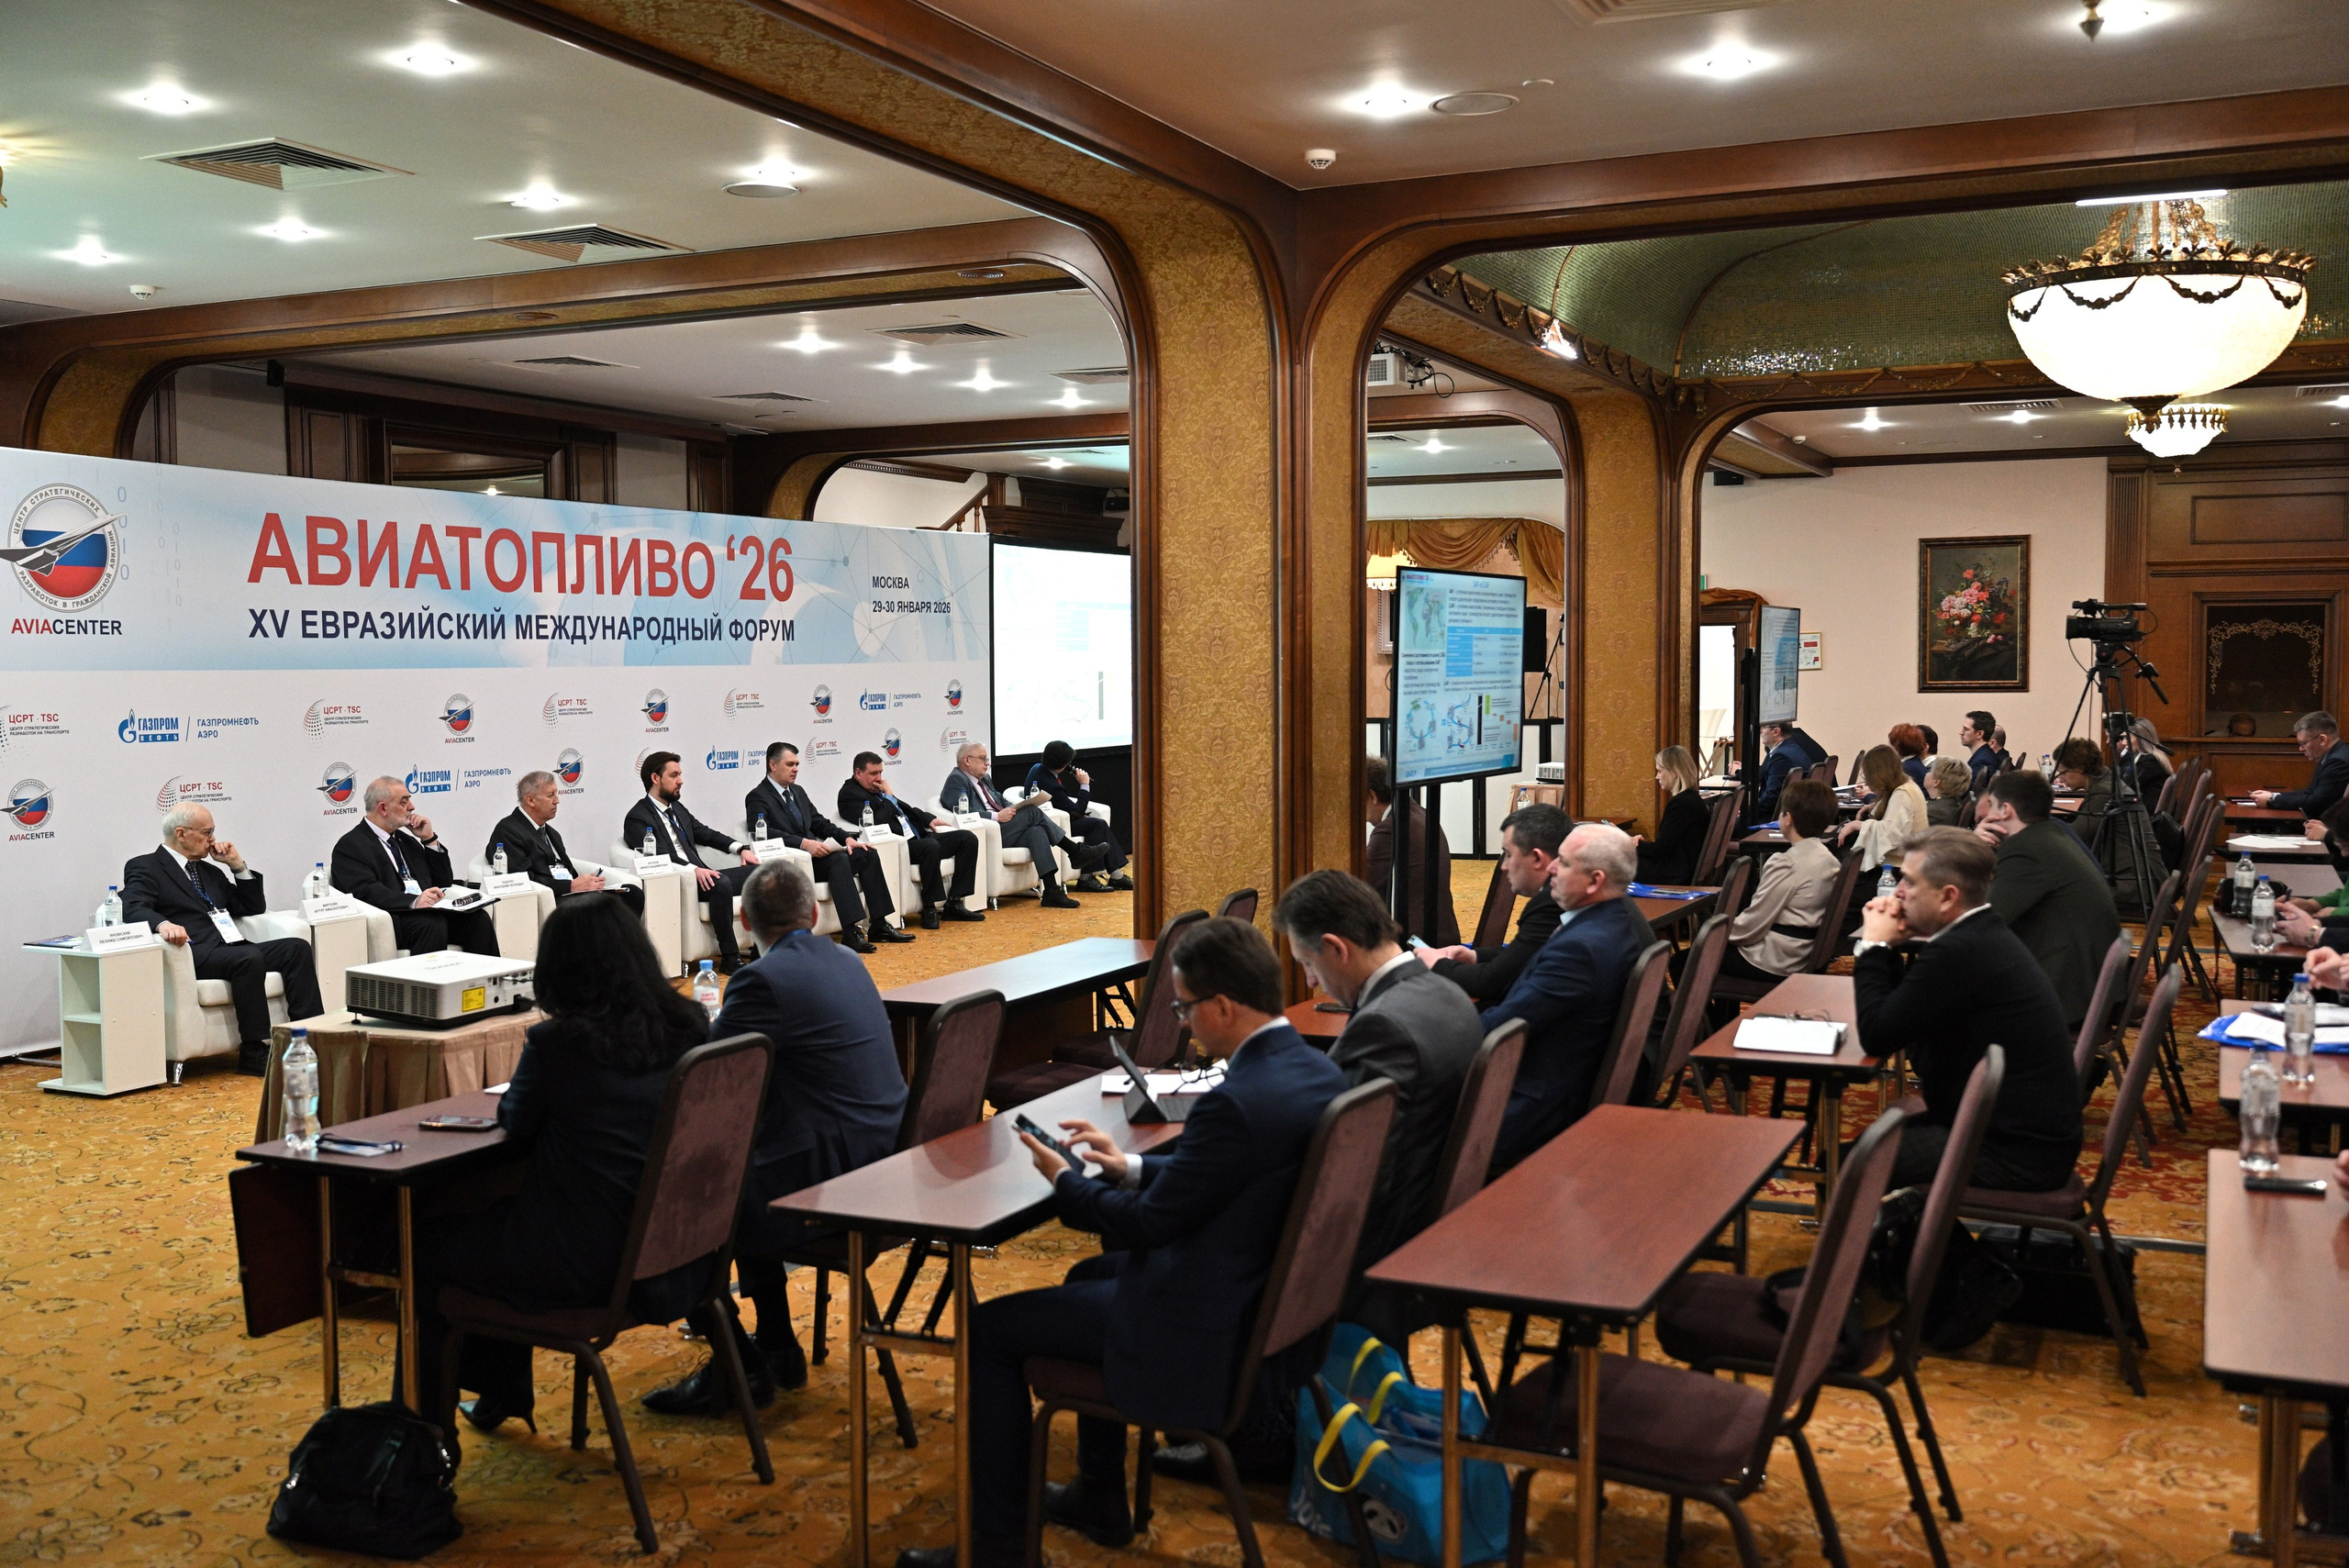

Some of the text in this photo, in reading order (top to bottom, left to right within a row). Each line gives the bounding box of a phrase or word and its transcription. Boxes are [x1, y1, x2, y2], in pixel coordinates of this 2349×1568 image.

[14, 488, 100, 535] ЦЕНТР СТРАТЕГИЧЕСКИХ
[247, 512, 716, 599] АВИАТОПЛИВО
[18, 571, 59, 607] РАЗРАБОТОК
[107, 530, 117, 570] АВИАЦИИ
[872, 575, 910, 589] МОСКВА
[873, 600, 952, 614] 29-30 ЯНВАРЯ 2026
[11, 617, 123, 636] AVIACENTER
[248, 605, 795, 645] XV ЕВРАЗИЙСКИЙ МЕЖДУНАРОДНЫЙ ФОРУМ
[557, 699, 573, 707] ЦСРТ
[868, 693, 886, 702] ГАЗПРОМ
[323, 706, 362, 715] ЦСРТ TSC
[8, 713, 59, 725] ЦСРТ TSC
[138, 717, 179, 731] ГАЗПРОМ
[196, 717, 260, 728] ГАЗПРОМНЕФТЬ
[197, 729, 218, 739] АЭРО
[717, 751, 739, 761] ГАЗПРОМ
[419, 770, 451, 783] ГАЗПРОМ
[464, 768, 512, 778] ГАЗПРОМНЕФТЬ
[180, 782, 223, 793] ЦСРТ TSC
[464, 780, 481, 788] АЭРО
[323, 807, 358, 816] AVIACENTER
[9, 831, 55, 841] AVIACENTER
